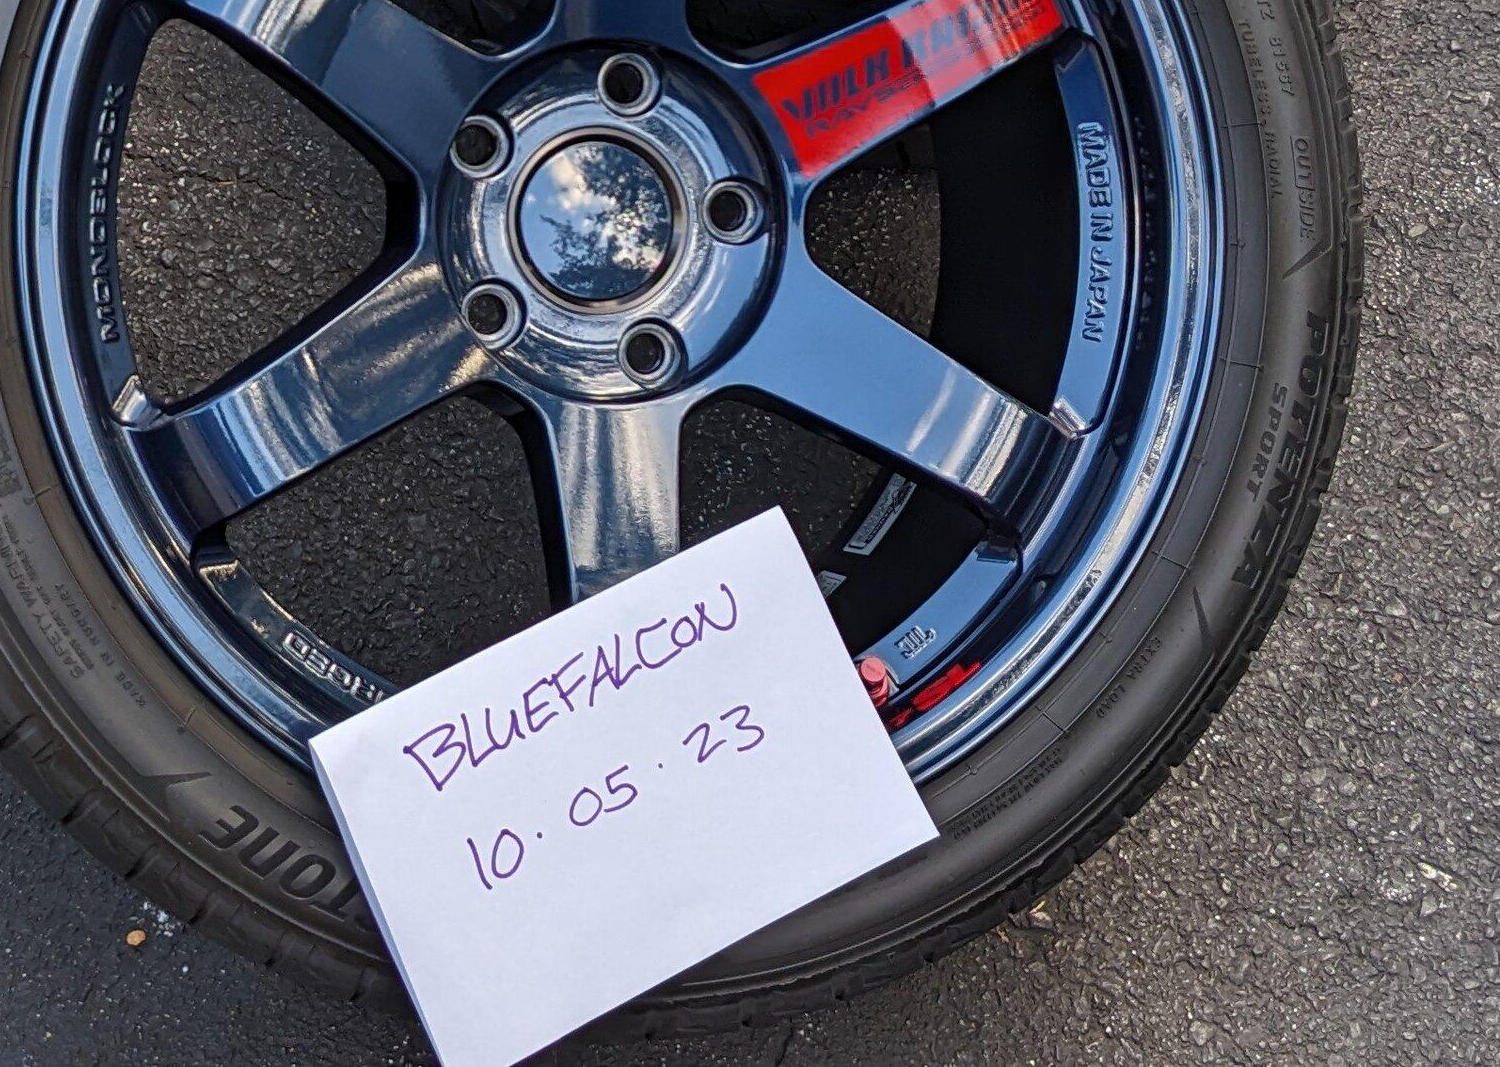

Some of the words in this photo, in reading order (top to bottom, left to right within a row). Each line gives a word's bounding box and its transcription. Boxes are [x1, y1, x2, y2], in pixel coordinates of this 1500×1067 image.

[90, 82, 127, 344] MONOBLOCK
[1078, 122, 1111, 203] MADE
[1091, 205, 1113, 243] IN
[1083, 245, 1113, 343] JAPAN
[1233, 309, 1328, 590] POTENZA
[1247, 382, 1287, 503] SPORT
[402, 583, 739, 792] BLUEFALCON
